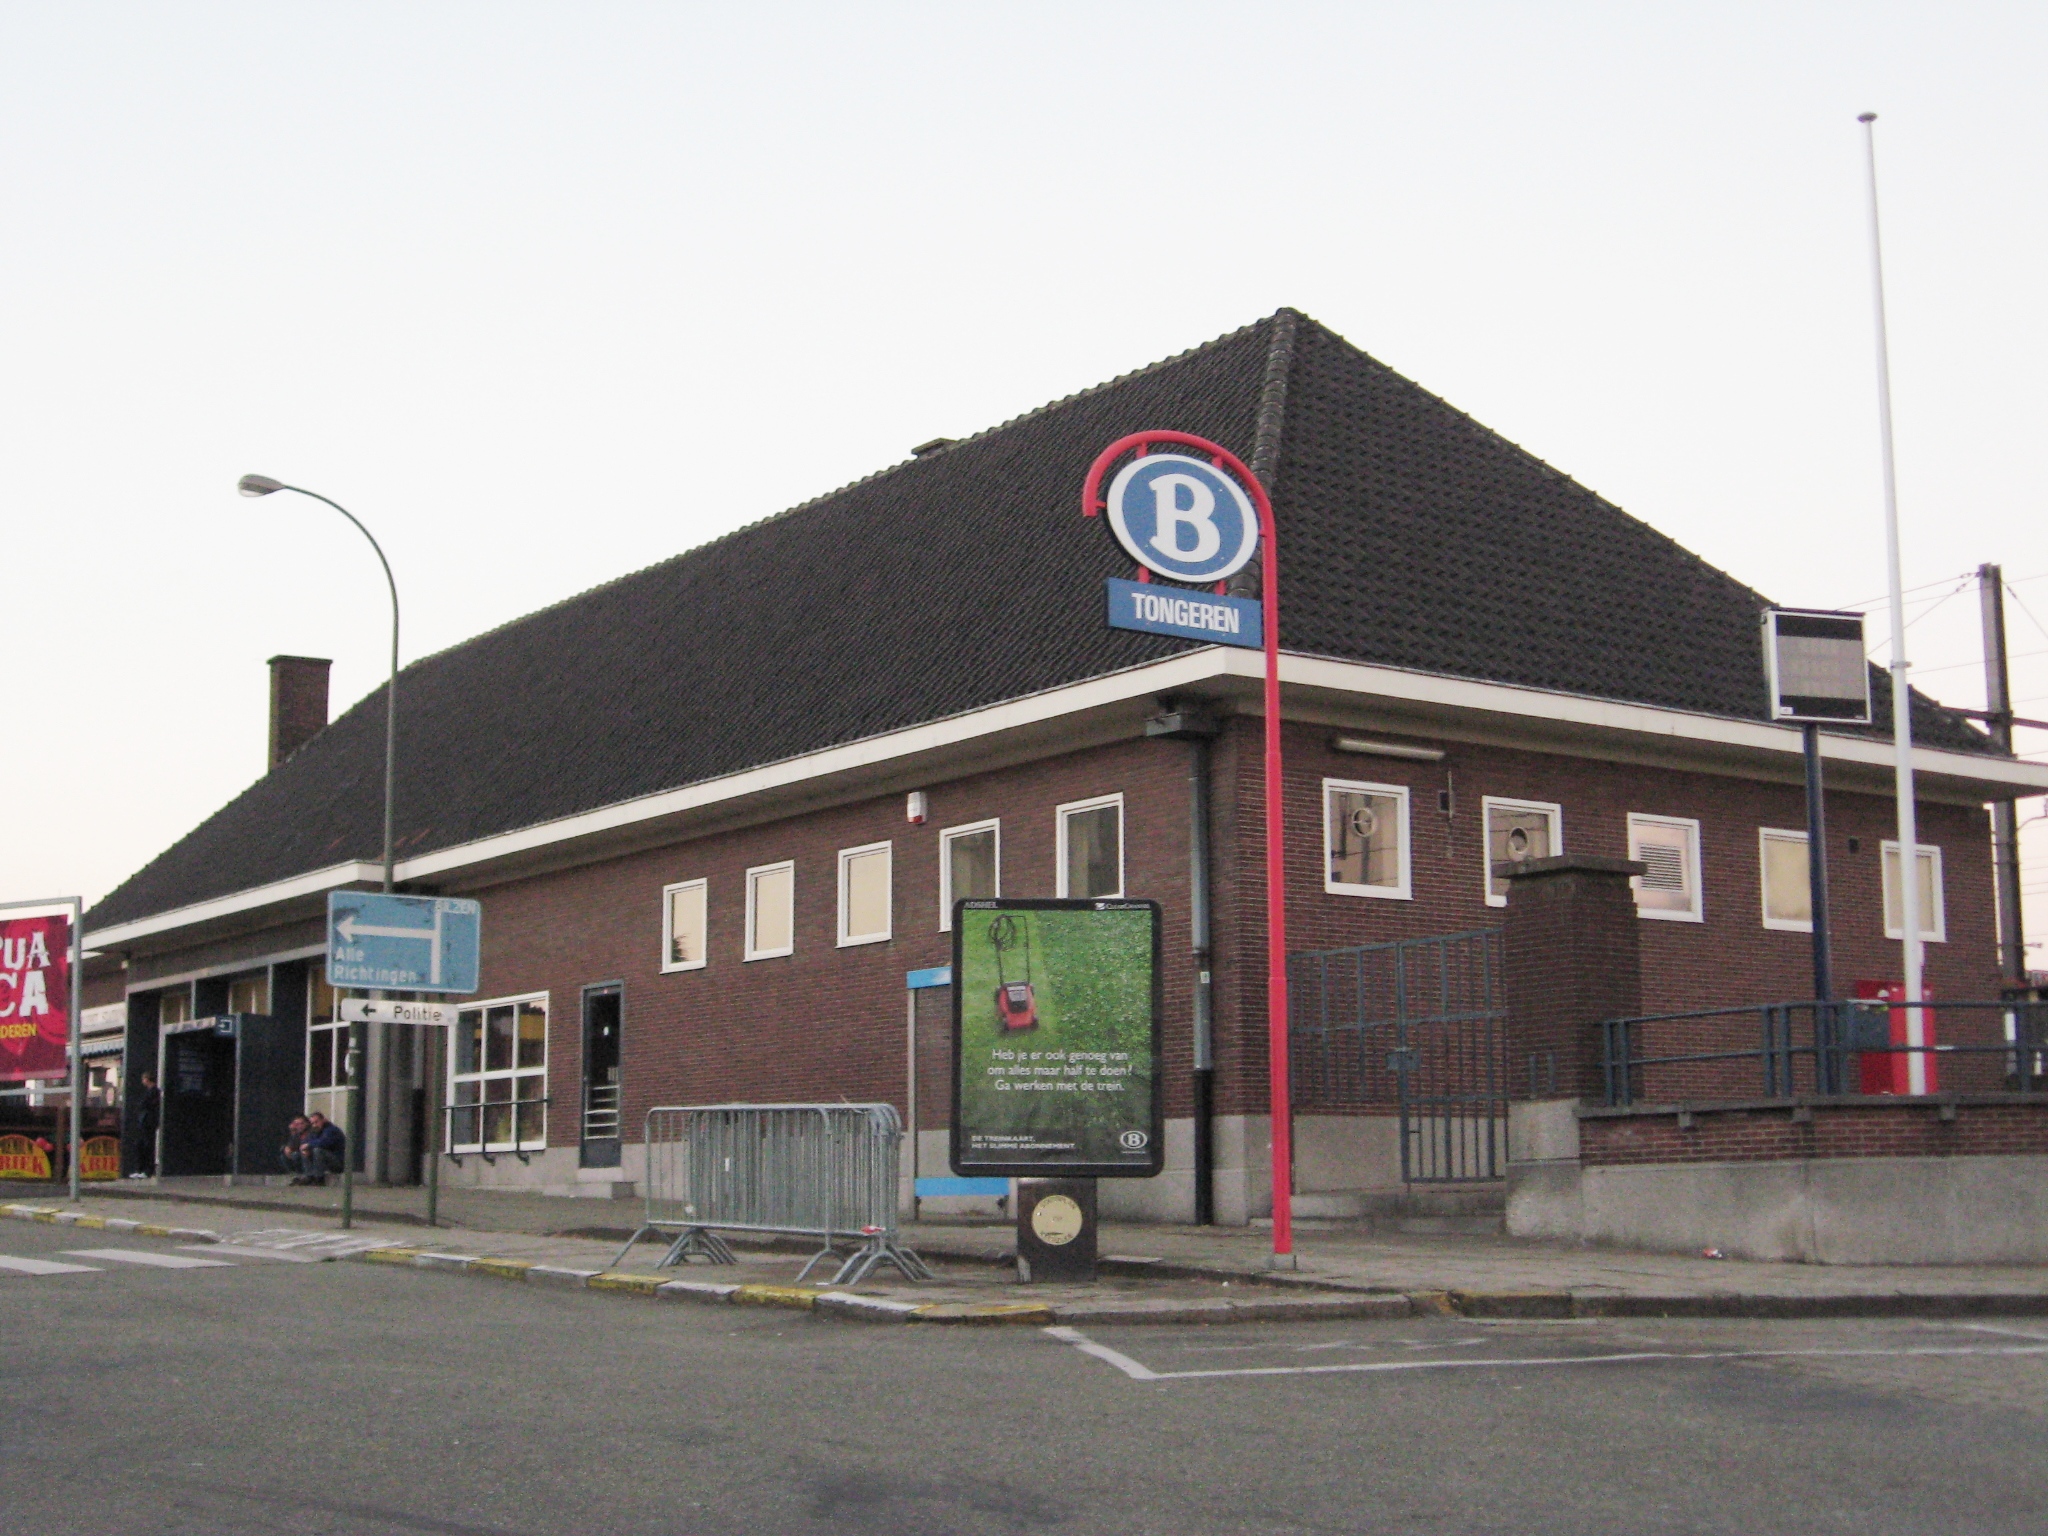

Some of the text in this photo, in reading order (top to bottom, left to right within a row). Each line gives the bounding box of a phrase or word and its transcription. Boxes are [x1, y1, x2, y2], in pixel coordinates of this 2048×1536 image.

[1149, 473, 1221, 563] B
[1131, 592, 1240, 634] TONGEREN
[335, 946, 365, 962] Alle
[333, 964, 418, 985] Richtingen
[393, 1005, 442, 1021] Politie
[992, 1049, 1128, 1064] Heb je er ook genoeg van
[987, 1067, 1005, 1075] om
[1008, 1065, 1031, 1075] alles
[1034, 1067, 1060, 1075] maar
[1063, 1065, 1083, 1075] half
[1085, 1066, 1097, 1075] te
[994, 1080, 1125, 1091] Ga werken met de trein.
